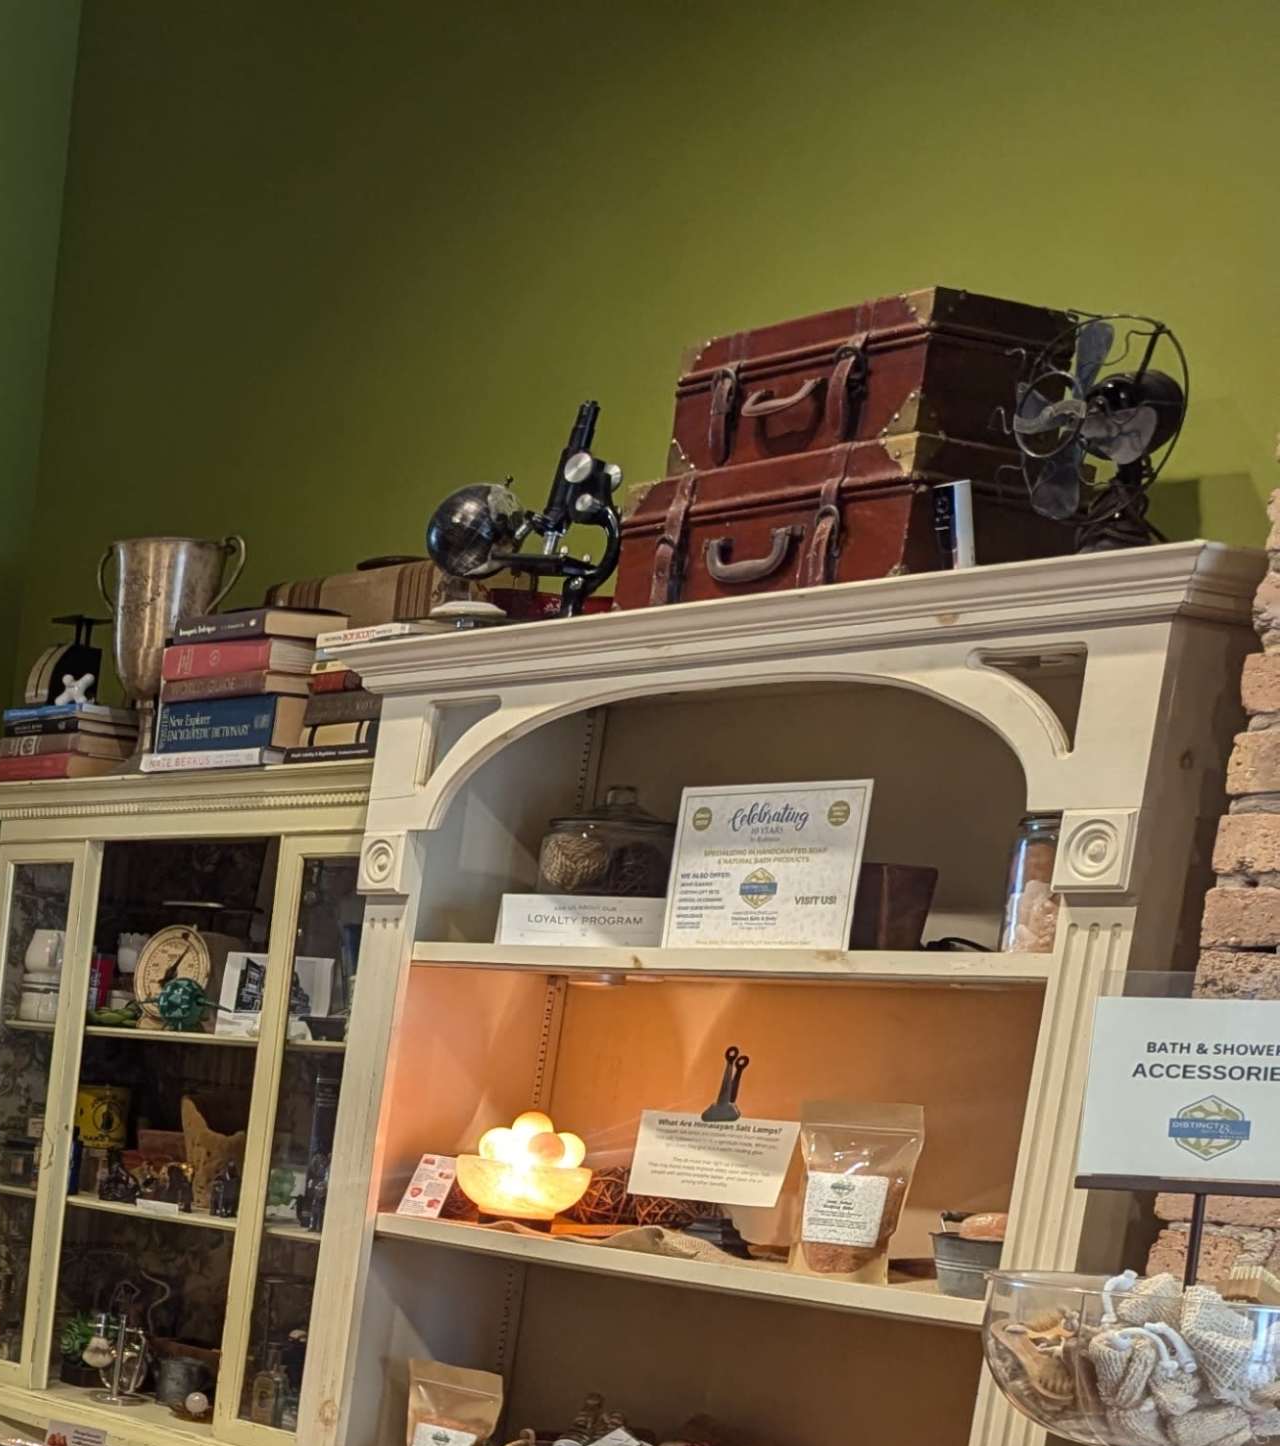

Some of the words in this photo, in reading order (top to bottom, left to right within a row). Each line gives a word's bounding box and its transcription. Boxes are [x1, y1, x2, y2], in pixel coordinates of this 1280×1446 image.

[728, 802, 809, 832] Celebrating
[794, 895, 819, 906] VISIT
[527, 913, 578, 925] LOYALTY
[581, 915, 644, 927] PROGRAM
[1146, 1041, 1191, 1054] BATH
[1196, 1042, 1208, 1055] &
[1132, 1063, 1280, 1082] ACCESSORIE
[658, 1118, 679, 1128] What
[679, 1120, 692, 1128] Are
[693, 1121, 735, 1132] Himalayan
[735, 1123, 751, 1133] Salt
[752, 1125, 783, 1136] Lamps?
